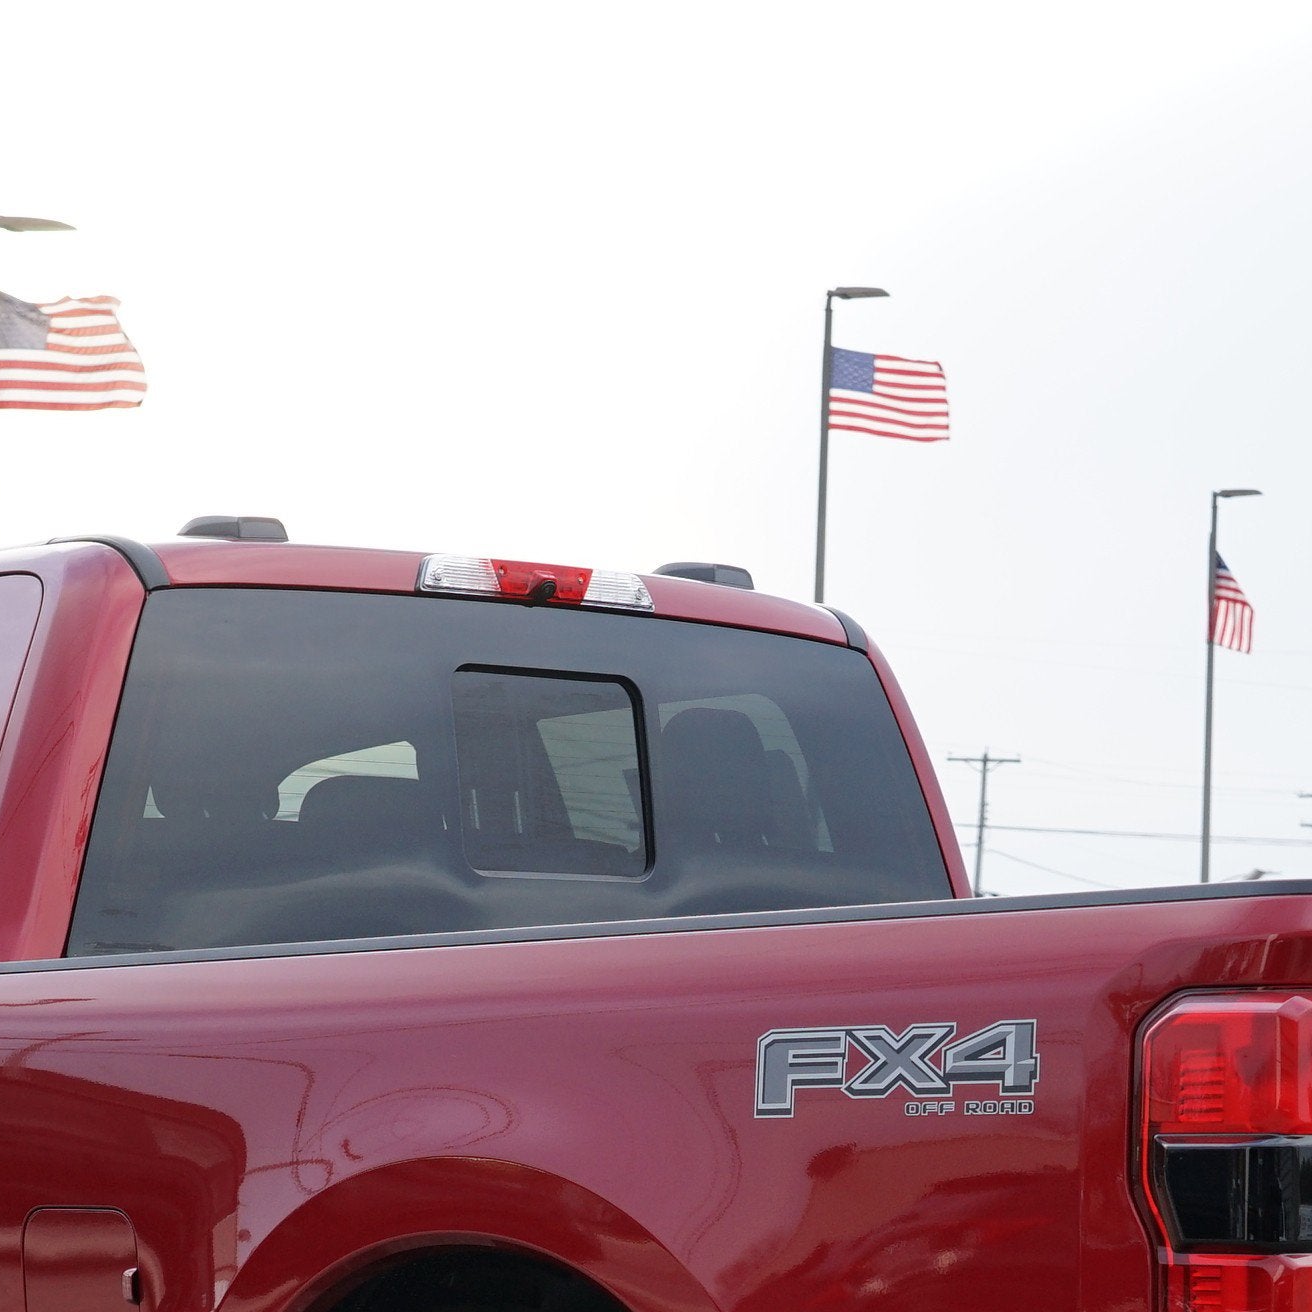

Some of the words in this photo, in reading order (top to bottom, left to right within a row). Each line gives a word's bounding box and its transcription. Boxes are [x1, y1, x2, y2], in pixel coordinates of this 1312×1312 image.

[754, 1018, 1040, 1118] FX4
[904, 1101, 955, 1116] OFF
[964, 1100, 1035, 1115] ROAD
